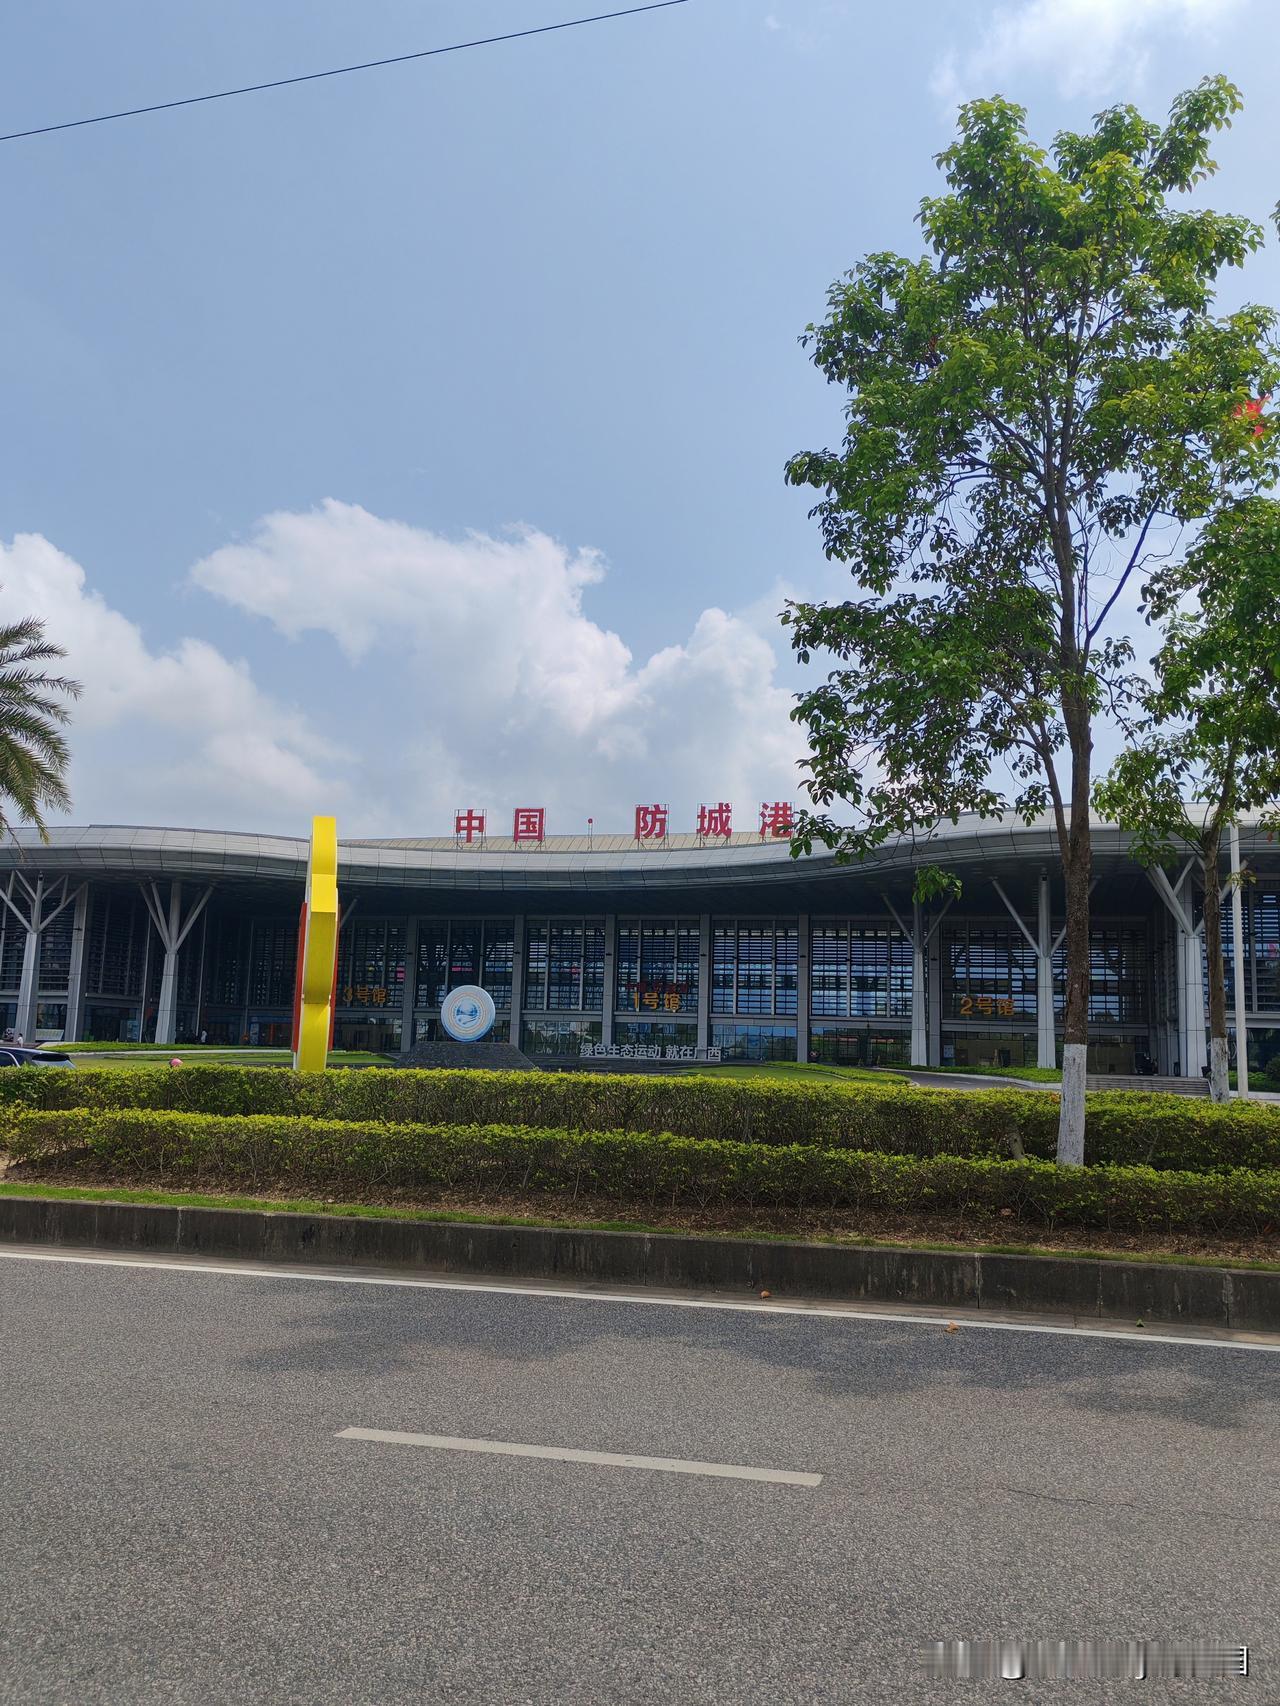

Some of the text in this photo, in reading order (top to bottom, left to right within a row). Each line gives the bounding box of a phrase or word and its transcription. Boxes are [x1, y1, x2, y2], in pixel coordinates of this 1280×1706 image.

[633, 992, 680, 1009] 1号馆
[960, 998, 1014, 1016] 2号馆
[580, 1043, 661, 1057] 绿色生态运动
